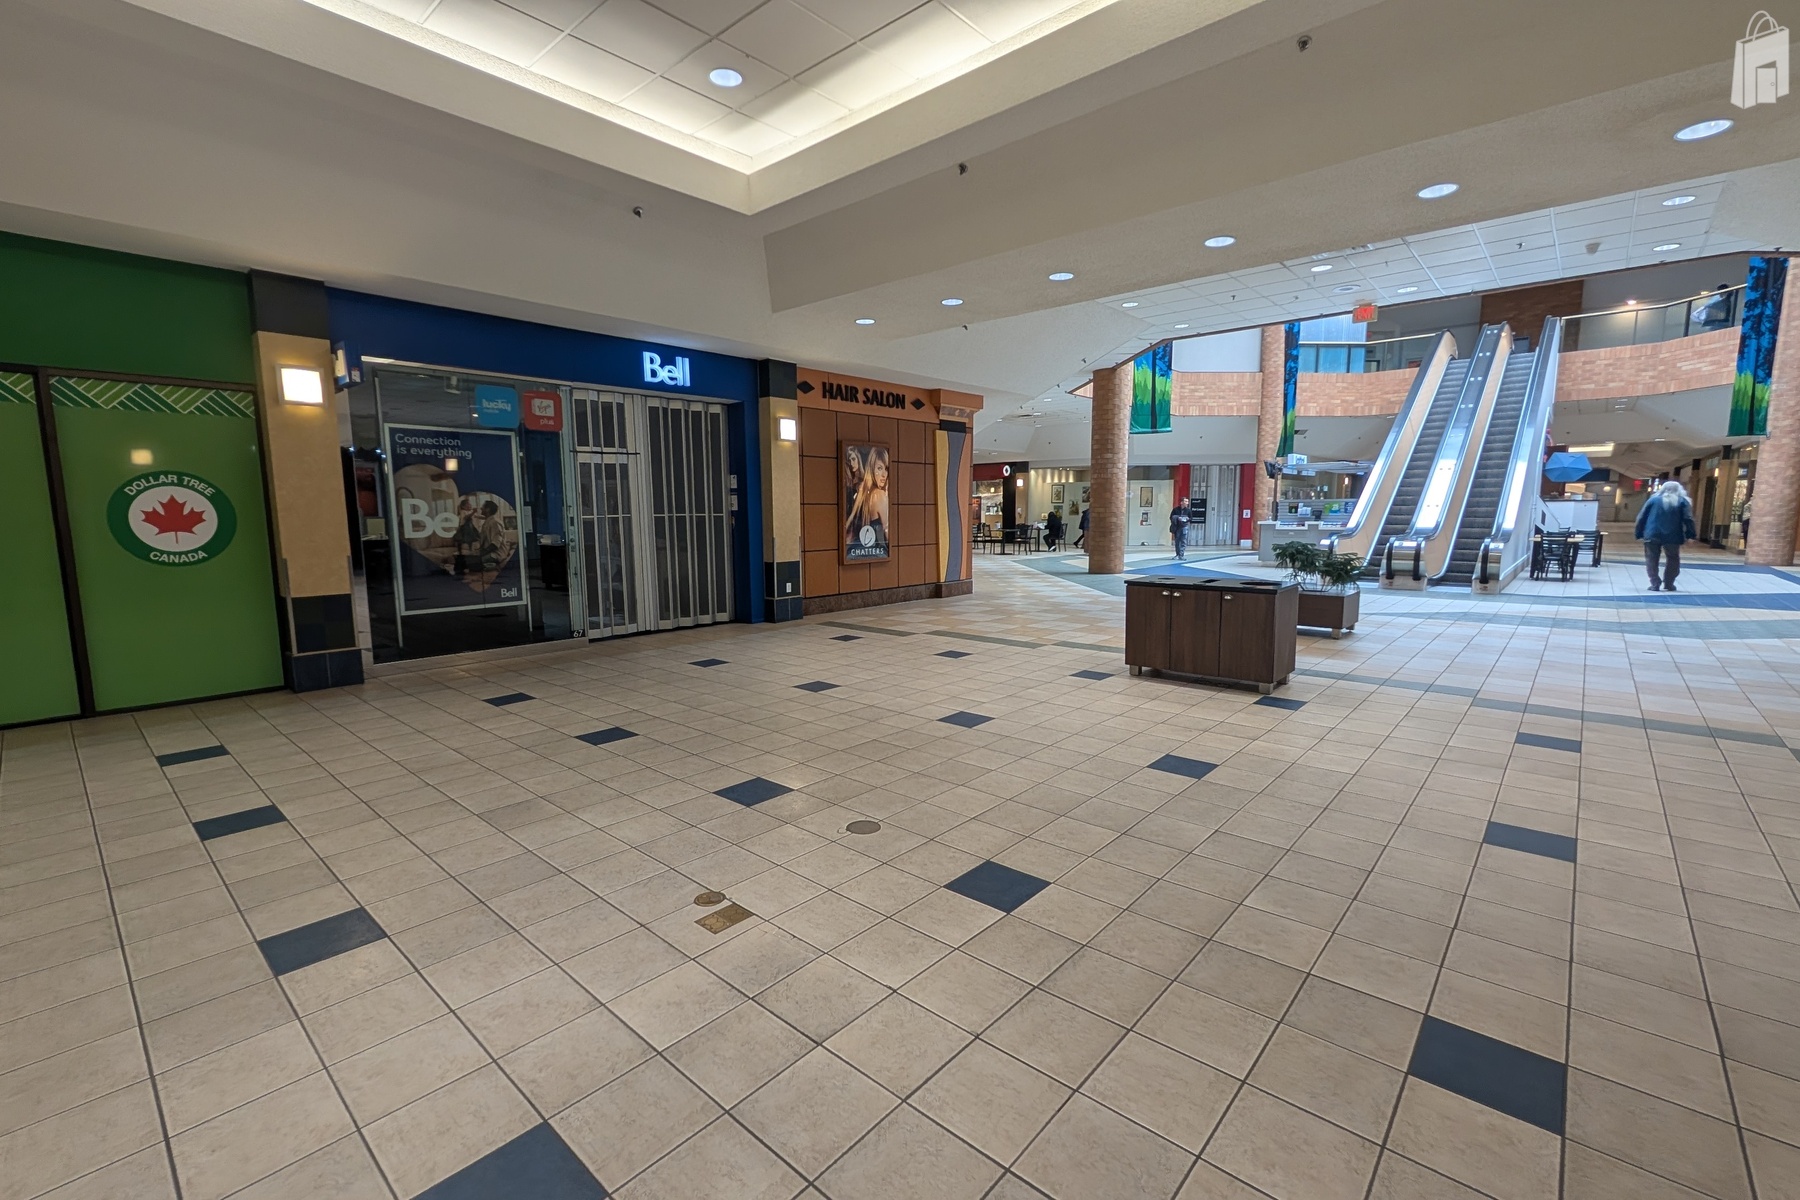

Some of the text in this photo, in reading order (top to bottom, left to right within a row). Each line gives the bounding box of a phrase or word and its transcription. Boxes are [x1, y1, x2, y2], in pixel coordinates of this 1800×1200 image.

[642, 351, 691, 387] Bell
[821, 381, 906, 410] HAIR SALON
[482, 398, 512, 412] lucky
[539, 418, 554, 426] plus
[395, 433, 461, 446] Connection
[396, 444, 472, 460] is everything
[124, 474, 216, 497] DOLLAR TREE
[149, 550, 208, 563] CANADA
[851, 547, 884, 556] CHATTERS
[500, 587, 518, 598] Bell
[573, 629, 583, 638] 67
